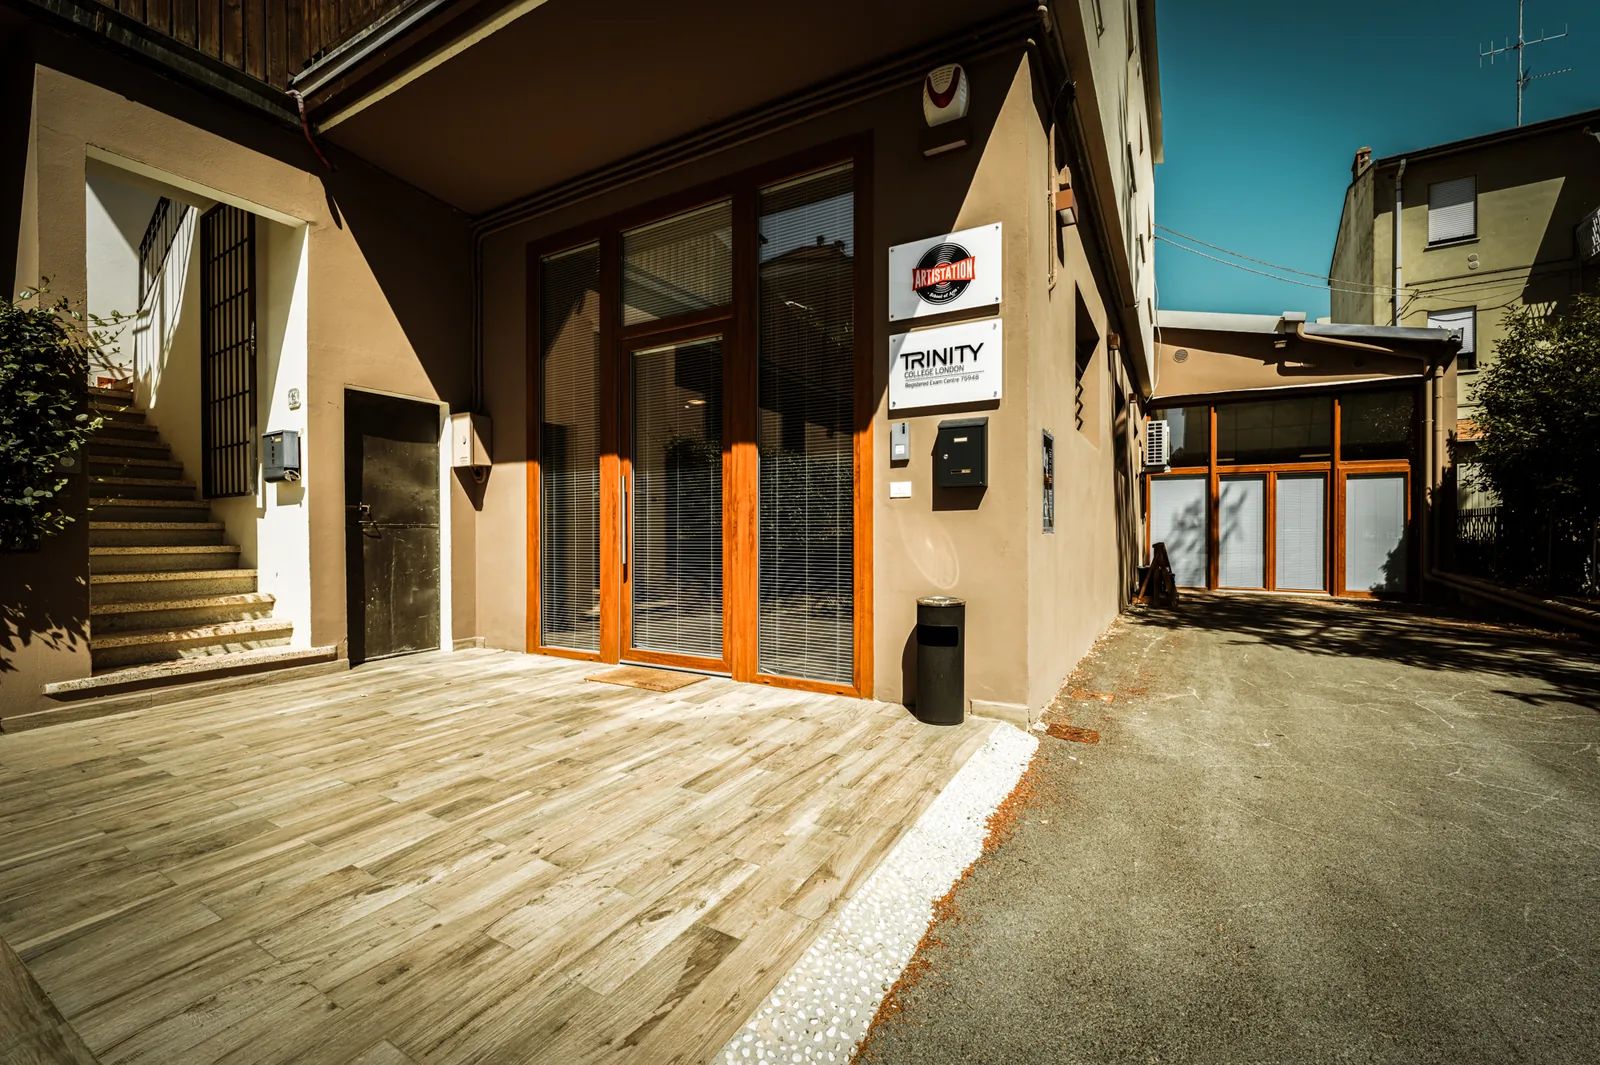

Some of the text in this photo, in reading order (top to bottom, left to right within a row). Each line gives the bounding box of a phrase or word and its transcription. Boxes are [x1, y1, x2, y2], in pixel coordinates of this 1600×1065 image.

[915, 258, 973, 289] ARTISTATION
[900, 342, 984, 370] TRINITY
[904, 365, 965, 378] COLLEGE LONDON
[905, 381, 929, 389] Registered
